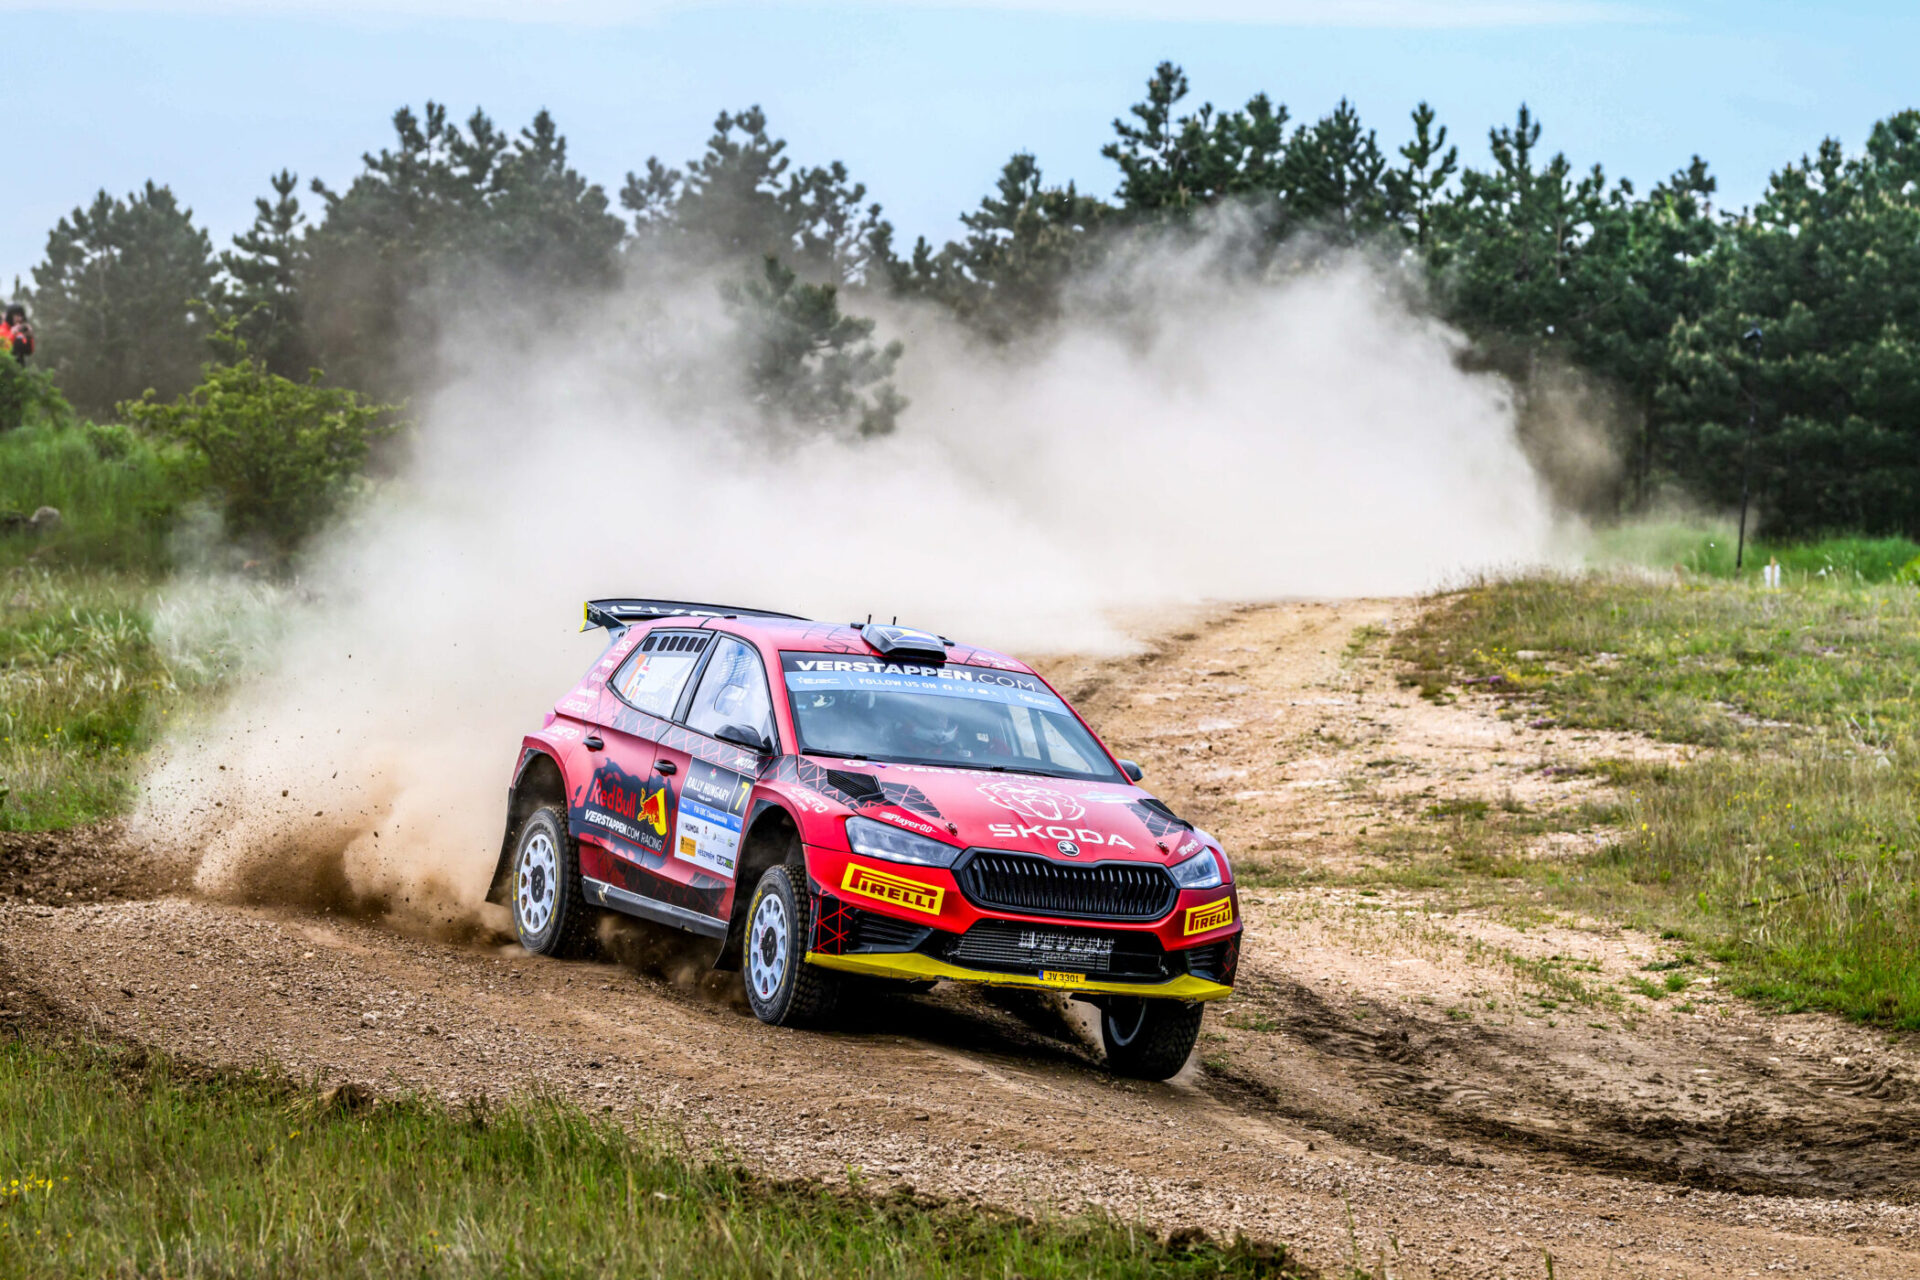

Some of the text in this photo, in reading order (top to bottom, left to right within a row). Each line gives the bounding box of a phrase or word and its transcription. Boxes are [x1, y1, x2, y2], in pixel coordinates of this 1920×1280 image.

[795, 660, 1036, 692] VERSTAPPEN.COM
[858, 678, 902, 687] FOLLOW
[686, 776, 704, 793] RALLY
[702, 782, 731, 802] HUNGARY
[734, 781, 751, 811] 7
[640, 832, 663, 852] RACING
[849, 868, 938, 910] PIRELLI
[1188, 900, 1231, 932] PIRELLI
[1047, 972, 1079, 983] JV 3301
